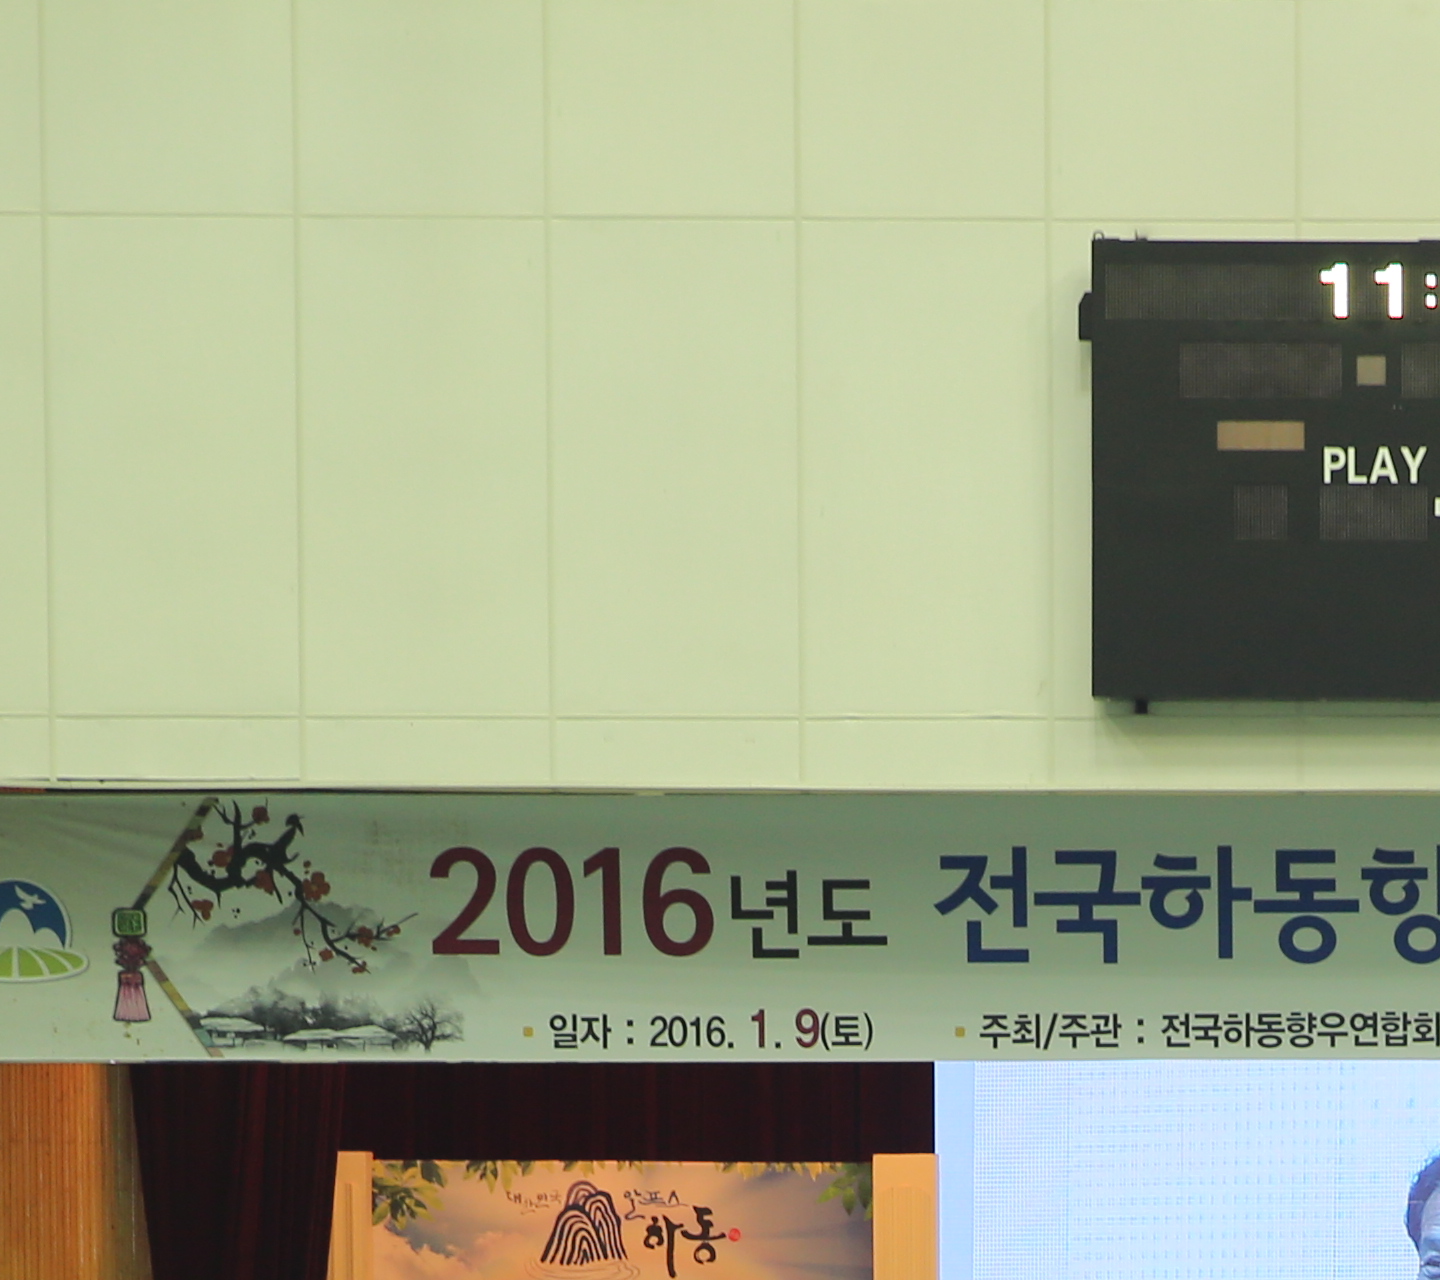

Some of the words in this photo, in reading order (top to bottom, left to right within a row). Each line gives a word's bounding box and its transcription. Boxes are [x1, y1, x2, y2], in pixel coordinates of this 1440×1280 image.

[1321, 446, 1427, 484] PLAY
[428, 846, 888, 960] 2016년도
[548, 1013, 613, 1050] 일자
[648, 1017, 735, 1050] 2016.
[978, 1011, 1122, 1051] 주최/주관
[643, 1205, 727, 1279] 하동
